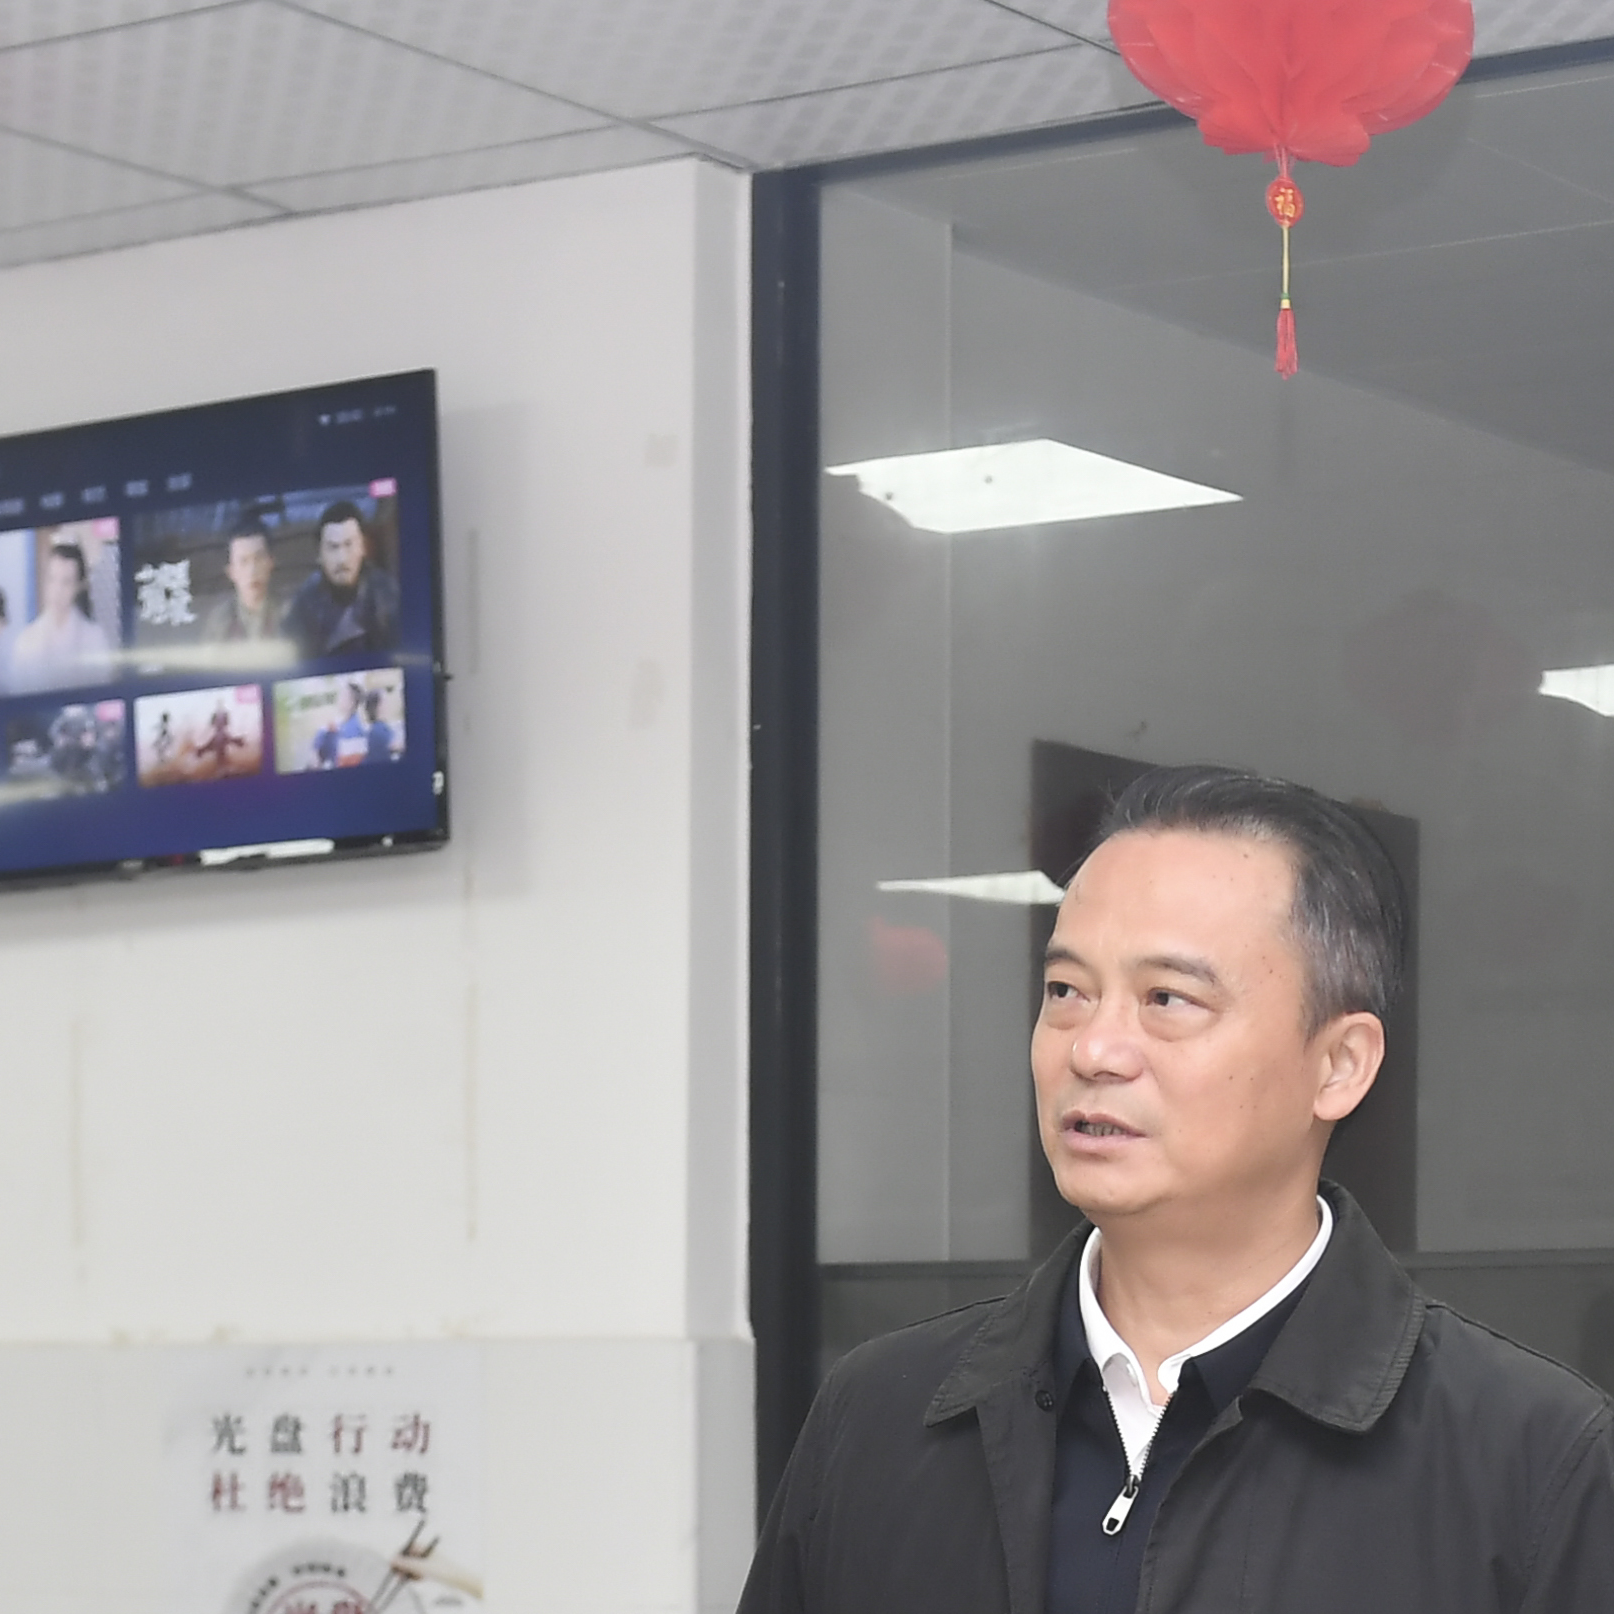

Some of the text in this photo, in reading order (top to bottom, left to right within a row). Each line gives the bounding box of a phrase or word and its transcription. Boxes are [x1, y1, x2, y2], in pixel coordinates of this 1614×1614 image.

[1274, 187, 1297, 218] 福
[210, 1412, 432, 1457] 光盘行动
[210, 1470, 430, 1515] 杜绝浪费
